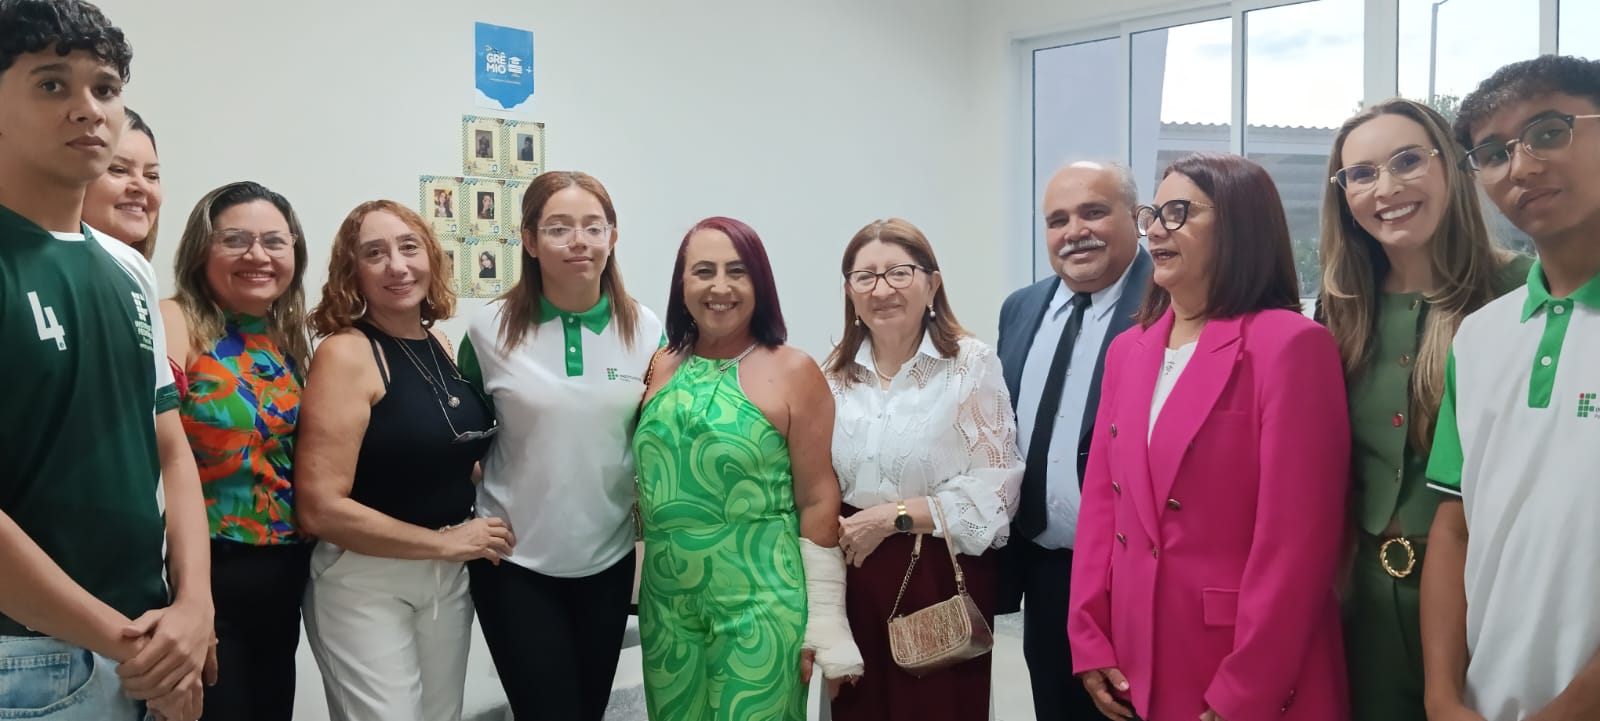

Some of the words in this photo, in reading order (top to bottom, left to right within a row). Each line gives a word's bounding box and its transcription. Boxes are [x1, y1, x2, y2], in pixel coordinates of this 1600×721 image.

[486, 52, 507, 65] GRÊ
[486, 63, 507, 74] MIO
[27, 291, 67, 351] 4
